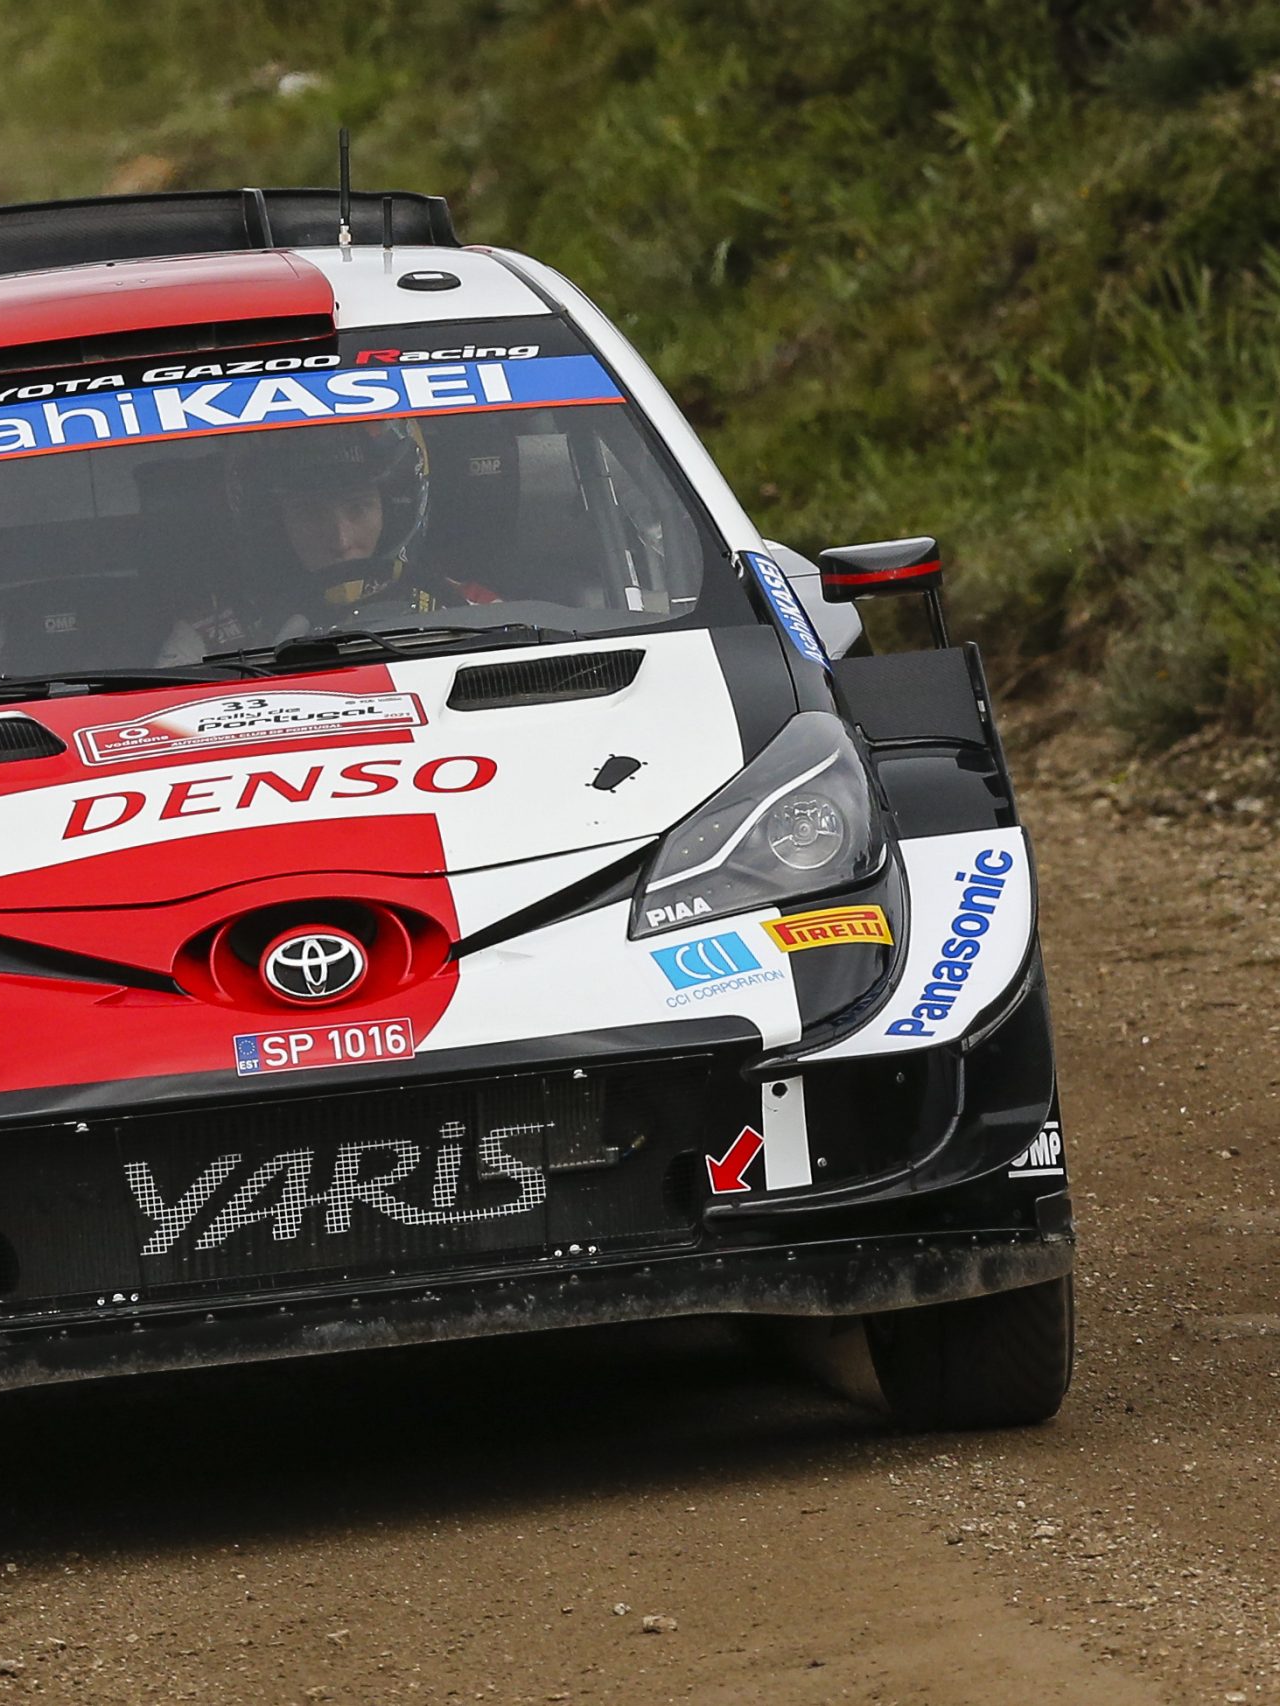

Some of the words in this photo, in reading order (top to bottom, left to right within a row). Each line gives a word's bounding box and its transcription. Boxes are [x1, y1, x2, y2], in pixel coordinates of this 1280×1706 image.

[142, 354, 341, 383] GAZOO
[355, 345, 540, 363] Racing
[45, 616, 76, 630] OMP
[199, 712, 262, 723] rally
[268, 707, 301, 715] de
[221, 698, 269, 712] 33
[104, 735, 169, 749] vodafone
[286, 723, 343, 733] PORTUGAL
[62, 756, 498, 840] DENSO
[646, 897, 713, 928] PIAA
[773, 911, 885, 945] PIRELLI
[885, 849, 1014, 1037] Panasonic
[666, 991, 691, 1008] CCI
[693, 969, 785, 1001] CORPORATION
[262, 1034, 314, 1067] SP
[328, 1024, 408, 1060] 1016
[239, 1059, 260, 1071] EST
